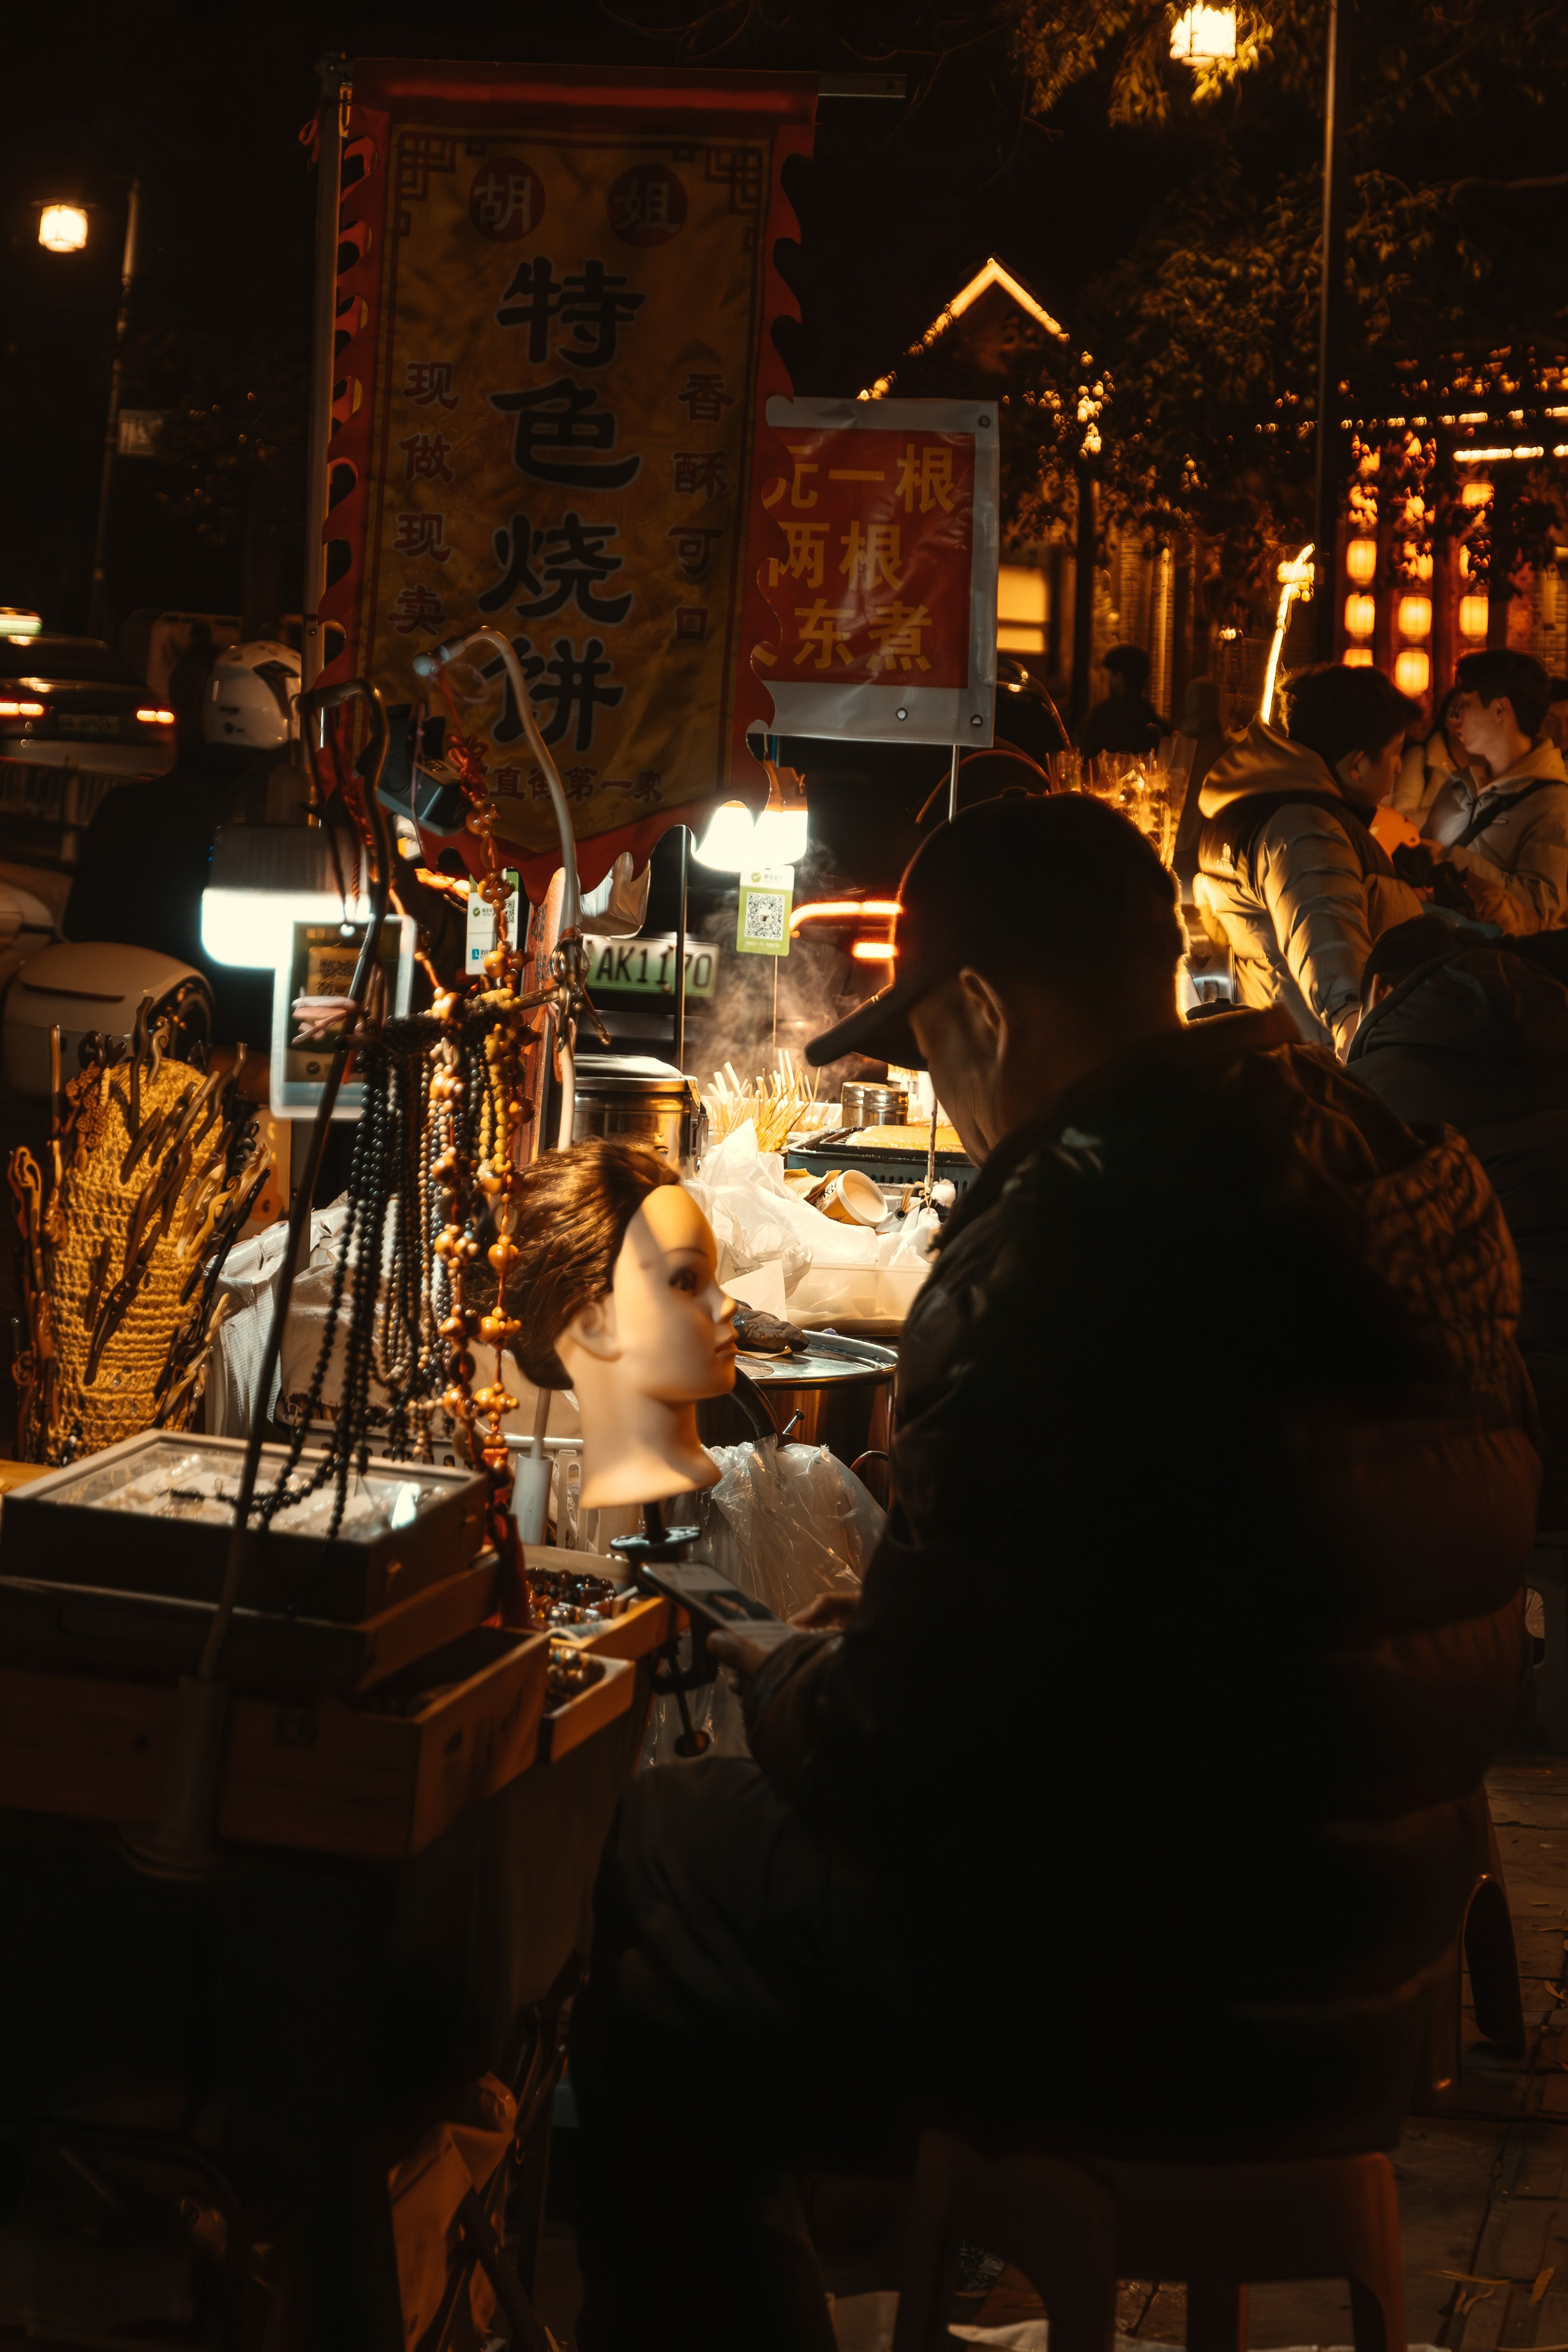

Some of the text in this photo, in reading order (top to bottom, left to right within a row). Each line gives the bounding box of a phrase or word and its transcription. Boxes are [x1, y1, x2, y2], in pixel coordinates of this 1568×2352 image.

[474, 172, 681, 234] 胡姐
[388, 360, 459, 635] 现做现卖
[478, 256, 646, 752] 特色烧饼
[667, 373, 734, 641] 香酥可口
[752, 598, 932, 673] 东煮
